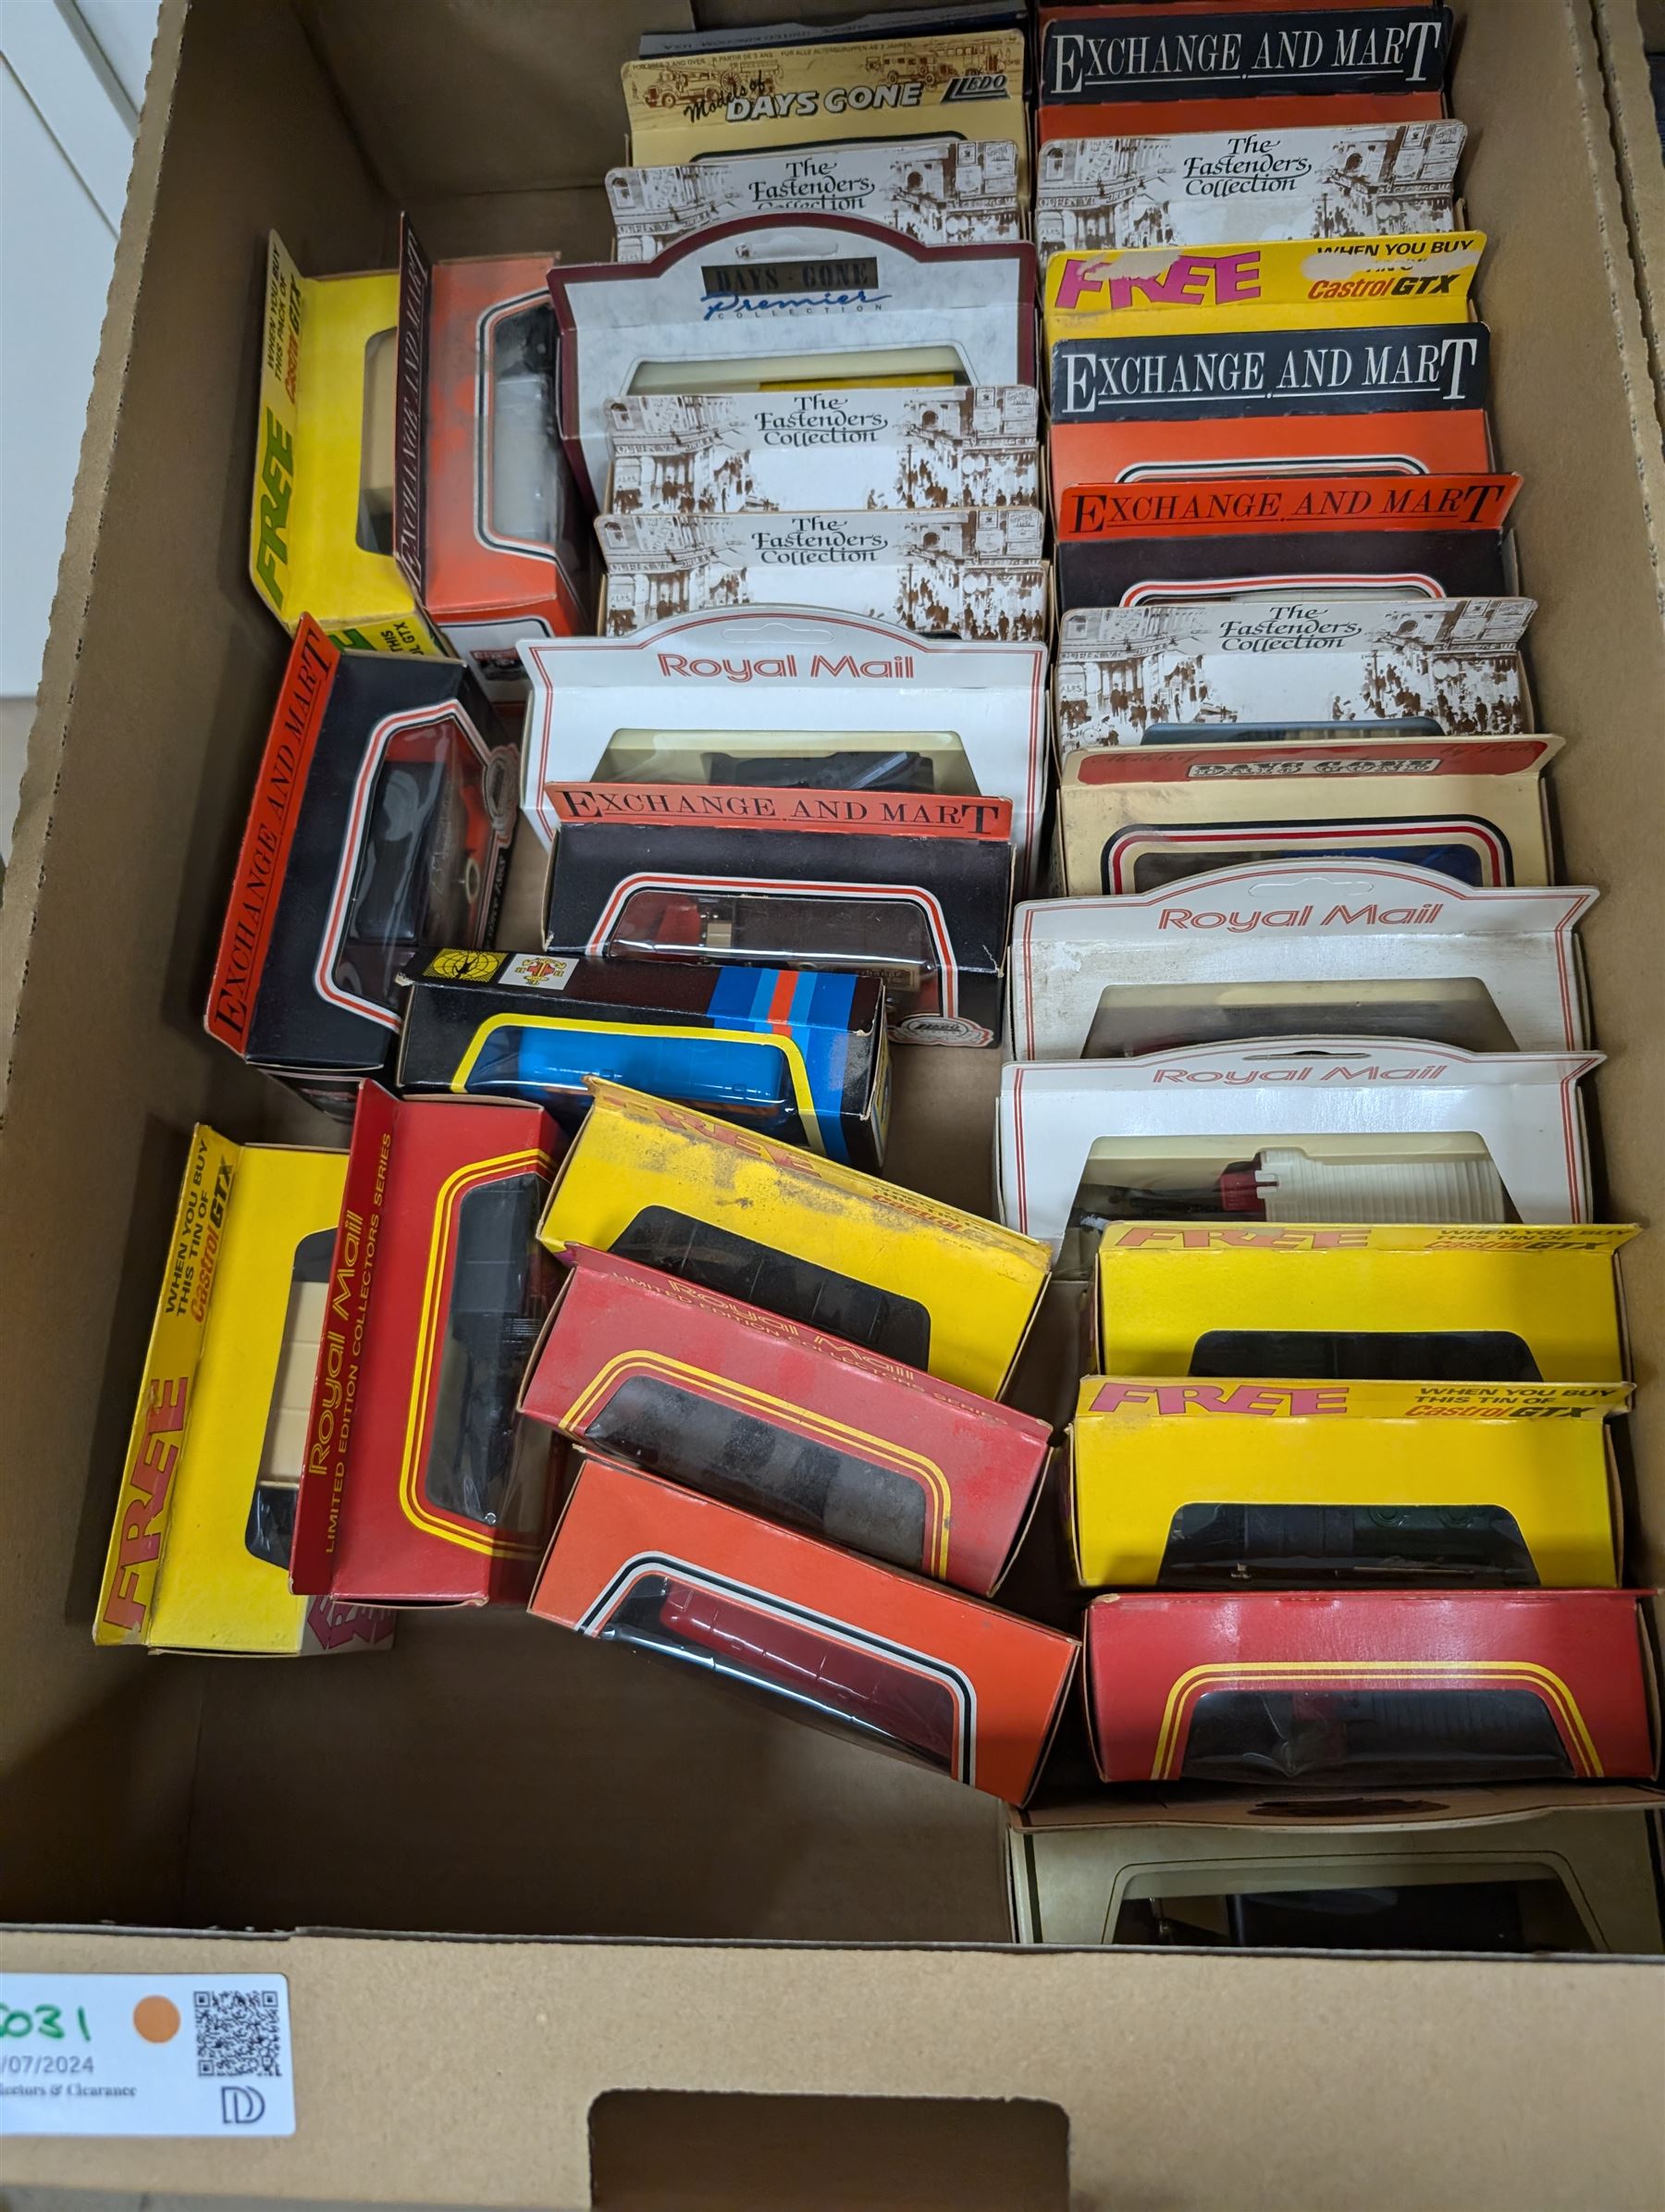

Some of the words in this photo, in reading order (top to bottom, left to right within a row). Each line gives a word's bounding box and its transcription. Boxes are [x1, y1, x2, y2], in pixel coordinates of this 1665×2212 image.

[1051, 32, 1241, 94] EXCHANGE
[1252, 30, 1323, 70] AND
[1331, 20, 1442, 81] MART
[684, 83, 746, 123] Models
[749, 69, 766, 91] of
[726, 91, 820, 123] DAYS
[823, 83, 924, 114] GONE
[1227, 134, 1280, 155] The
[785, 158, 837, 176] The
[1185, 173, 1297, 198] Collection
[1385, 241, 1426, 255] YOU
[1430, 239, 1474, 253] BUY
[715, 266, 779, 291] DAYS
[1055, 251, 1262, 310] FREE
[1308, 277, 1396, 300] Castrol
[1391, 274, 1461, 296] GTX
[290, 274, 302, 337] GTX
[700, 290, 893, 321] Premier
[718, 303, 882, 320] COLLECTION
[267, 316, 278, 370] WHEN
[275, 343, 283, 382] THIS
[1062, 352, 1264, 414] EXCHANGE
[1276, 348, 1351, 389] AND
[1362, 339, 1477, 400] MART
[794, 393, 848, 414] The
[764, 428, 878, 448] Collection
[257, 405, 294, 612] FREE
[792, 516, 847, 534] The
[1070, 492, 1283, 534] EXCHANGE
[1294, 489, 1373, 516] AND
[1381, 485, 1503, 524] MART
[760, 547, 877, 566] Collection
[1269, 604, 1327, 621] The
[393, 621, 416, 645] GTX
[1220, 634, 1345, 654] Collection
[657, 652, 797, 685] Royal
[810, 653, 915, 680] Mail
[561, 790, 776, 819] EXCHANGE
[791, 797, 869, 822] AND
[880, 802, 999, 835] MART
[213, 822, 278, 1038] EXCHANGE
[266, 744, 295, 820] AND
[284, 628, 333, 741] MART
[1157, 904, 1312, 933] Royal
[1320, 902, 1443, 927] Mail
[1153, 1066, 1312, 1087] Royal
[1321, 1065, 1448, 1082] Mail
[603, 1095, 822, 1179] FREE
[166, 1242, 187, 1313] WHEN
[182, 1192, 198, 1236] YOU
[192, 1139, 208, 1185] BUY
[872, 1194, 963, 1230] Castrol
[177, 1267, 194, 1316] THIS
[189, 1224, 204, 1259] TIN
[198, 1191, 210, 1218] OF
[191, 1225, 219, 1323] Castrol
[210, 1155, 233, 1230] GTX
[1116, 1227, 1371, 1250] FREE
[1524, 1241, 1611, 1250] GTX
[309, 1330, 346, 1475] Royal
[332, 1209, 364, 1321] Mail
[326, 1462, 346, 1554] LIMITED
[339, 1365, 359, 1453] EDITION
[352, 1214, 380, 1356] COLLECTORS
[374, 1133, 391, 1206] SERIES
[611, 1272, 693, 1304] LIMITED
[699, 1303, 780, 1337] EDITION
[789, 1336, 926, 1393] COLLECTORS
[668, 1279, 800, 1337] Royal
[814, 1335, 914, 1381] Mail
[1089, 1381, 1349, 1416] FREE
[1419, 1388, 1497, 1396] WHEN
[1506, 1389, 1558, 1397] YOU
[1561, 1389, 1617, 1397] BUY
[1404, 1404, 1511, 1417] Castrol
[1508, 1406, 1597, 1418] GTX
[104, 1377, 189, 1633] FREE
[50, 2083, 62, 2097] &
[68, 2083, 137, 2098] Clearance
